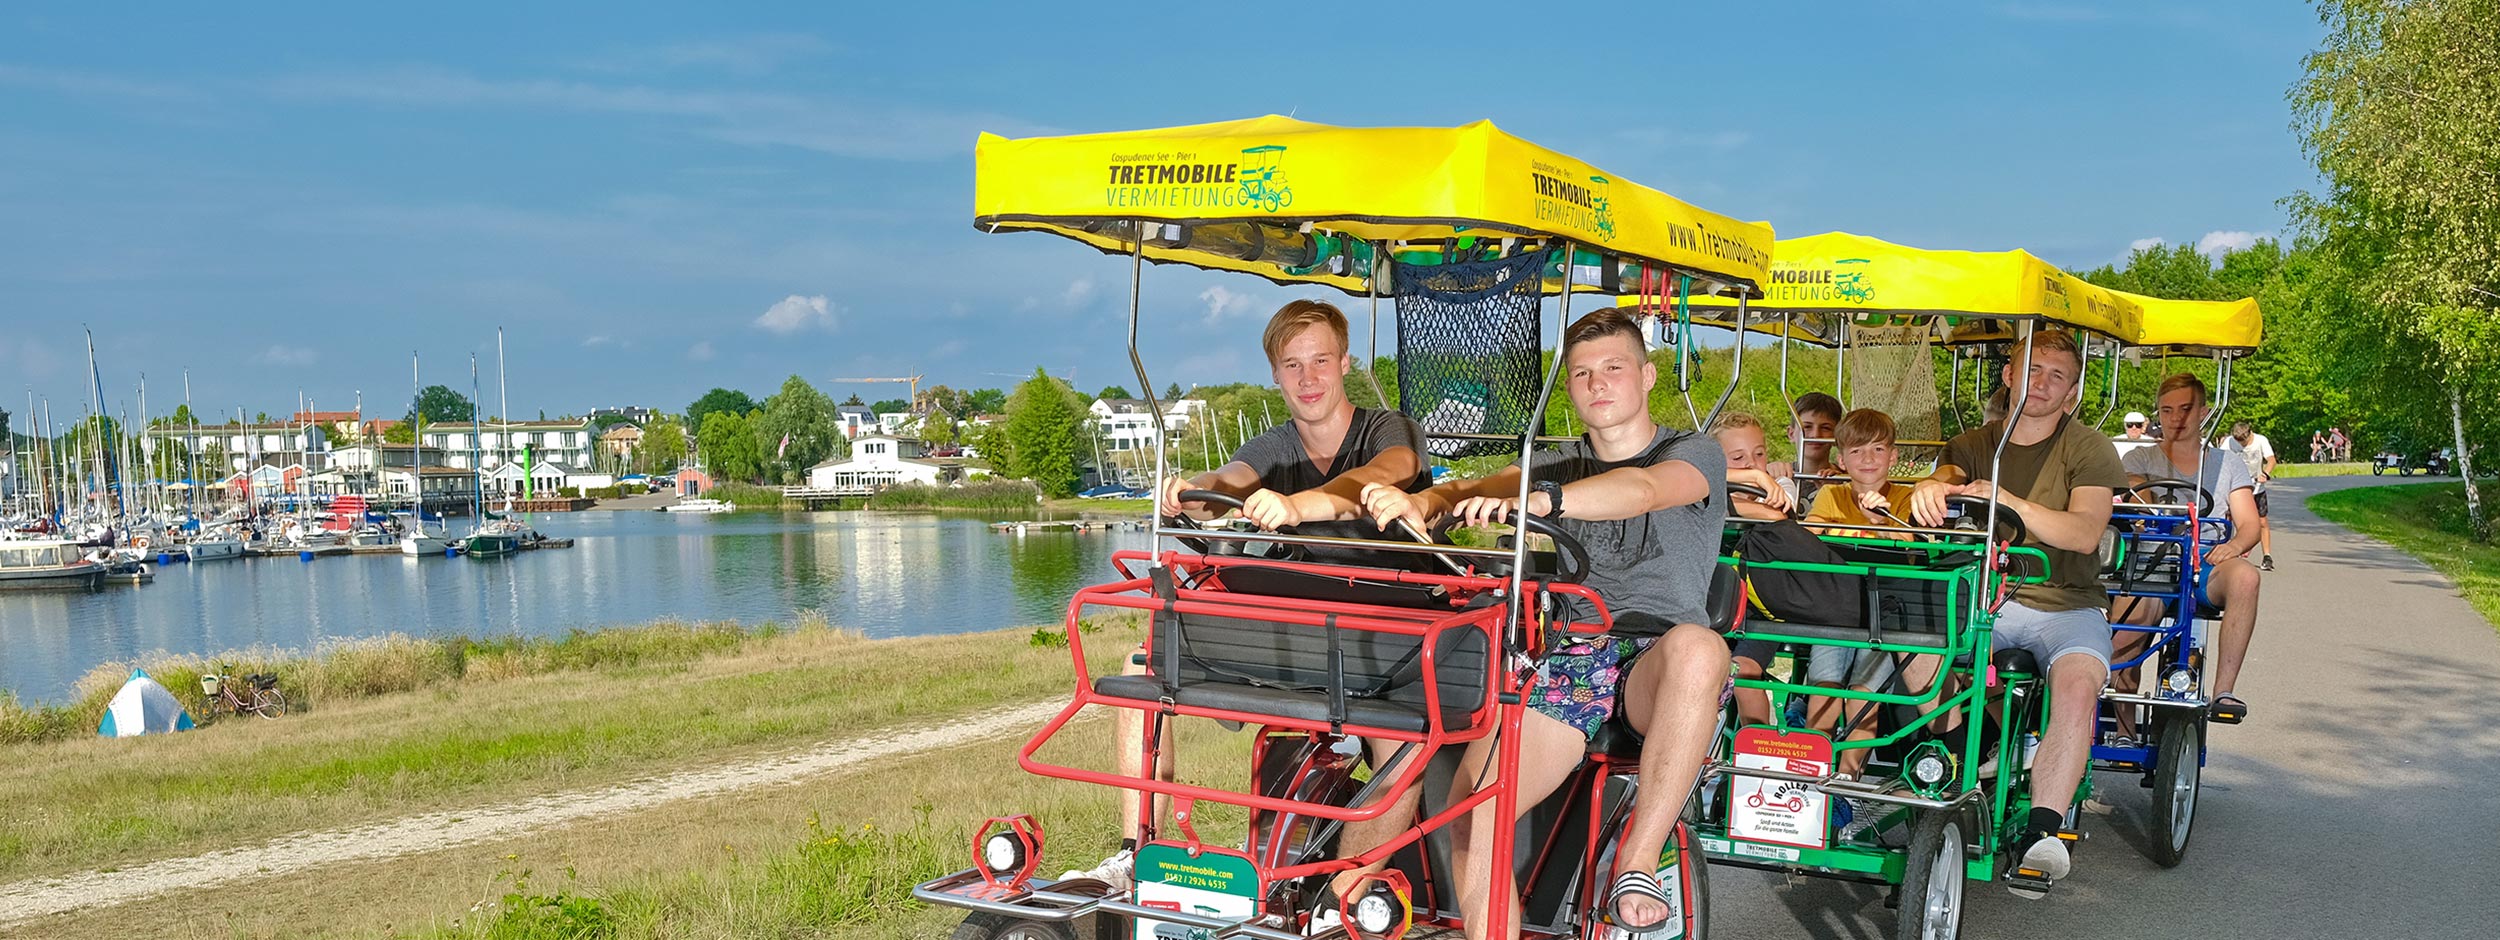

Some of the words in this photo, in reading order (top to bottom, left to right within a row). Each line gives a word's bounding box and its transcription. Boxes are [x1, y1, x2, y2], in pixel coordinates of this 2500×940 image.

[1111, 152, 1155, 163] Cospudener
[1157, 153, 1169, 161] See
[1176, 152, 1192, 161] Pier
[1109, 163, 1237, 185] TRETMOBILE
[1106, 186, 1233, 207] VERMIETUNG
[1532, 172, 1592, 209] TRETMOBILE
[1535, 197, 1593, 232] VERMIETUNG
[1766, 269, 1832, 284] MOBILE
[1774, 781, 1809, 800] ROLLER
[1158, 861, 1234, 879] www.tretmobile.com
[1188, 876, 1207, 886] 2924
[1208, 879, 1227, 890] 4535
